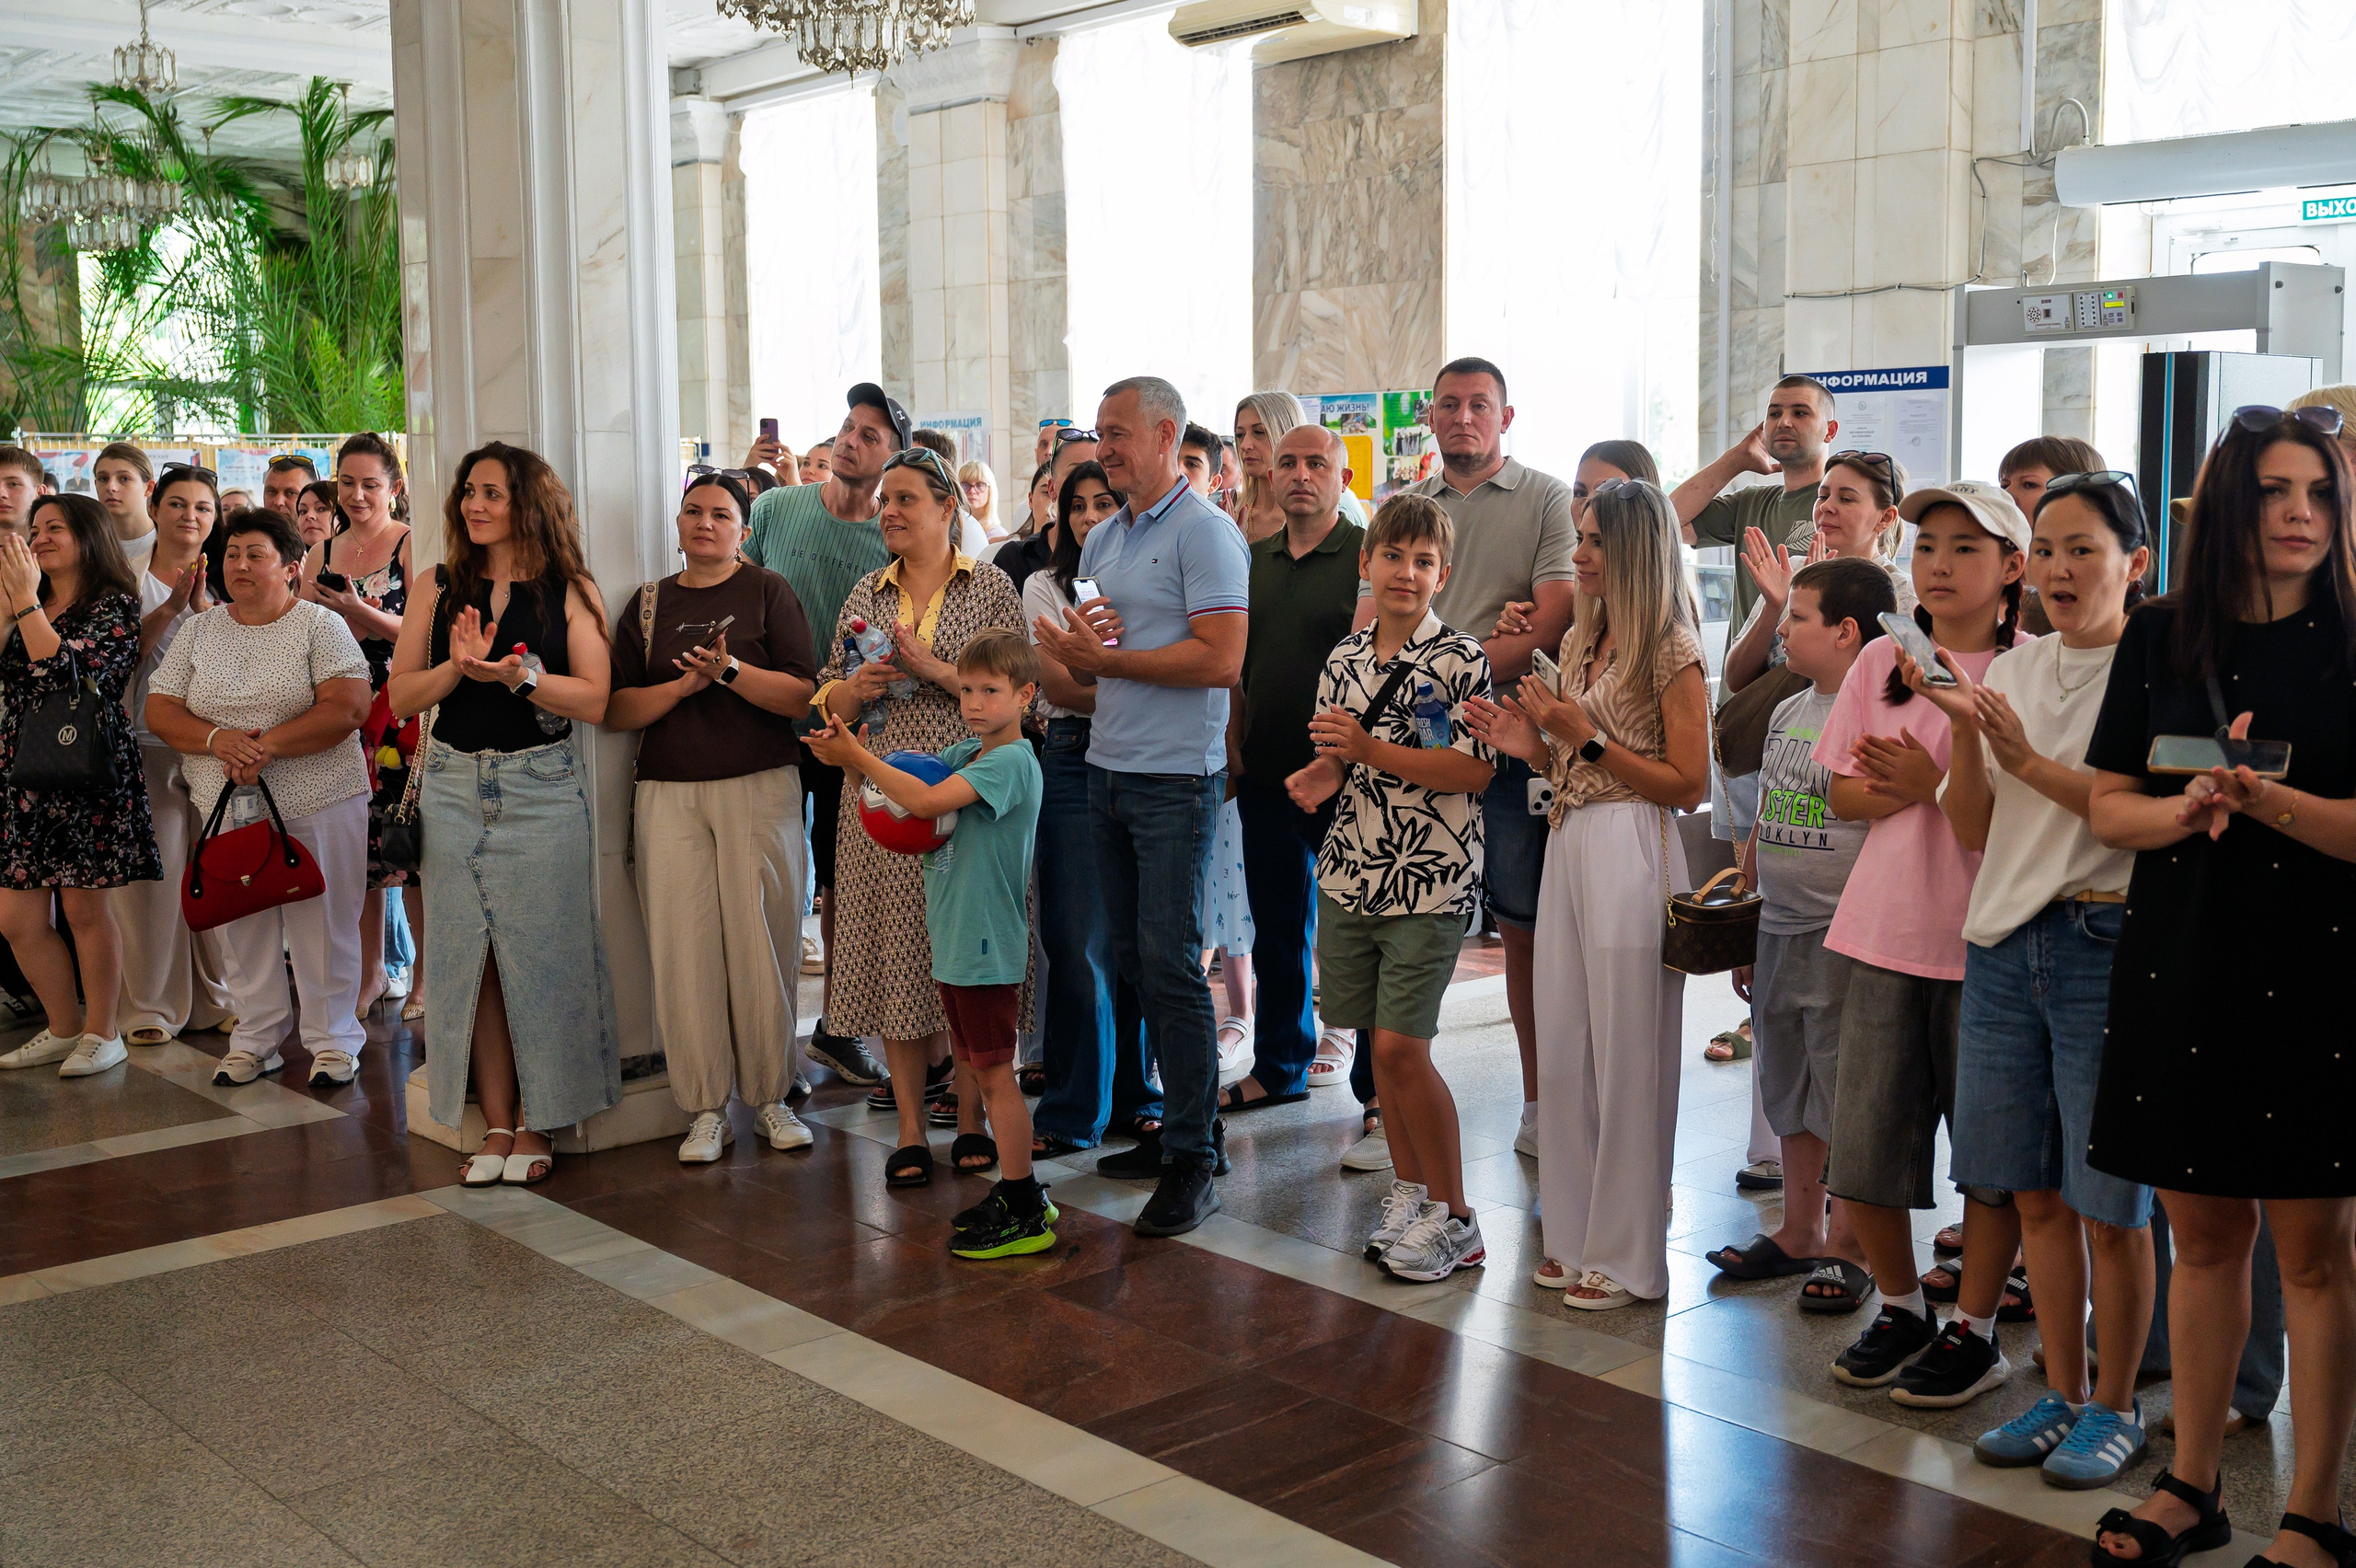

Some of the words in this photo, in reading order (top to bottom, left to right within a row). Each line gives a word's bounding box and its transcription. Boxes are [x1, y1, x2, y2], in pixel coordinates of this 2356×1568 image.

[1811, 371, 1927, 387] НФОРМАЦИЯ
[1336, 402, 1369, 413] ЖИЗНЬ!
[919, 417, 982, 430] ИНФОРМАЦИЯ
[791, 548, 804, 559] BE
[1418, 728, 1435, 742] BAR
[1761, 789, 1826, 829] STER
[1811, 1270, 1846, 1285] adidas
